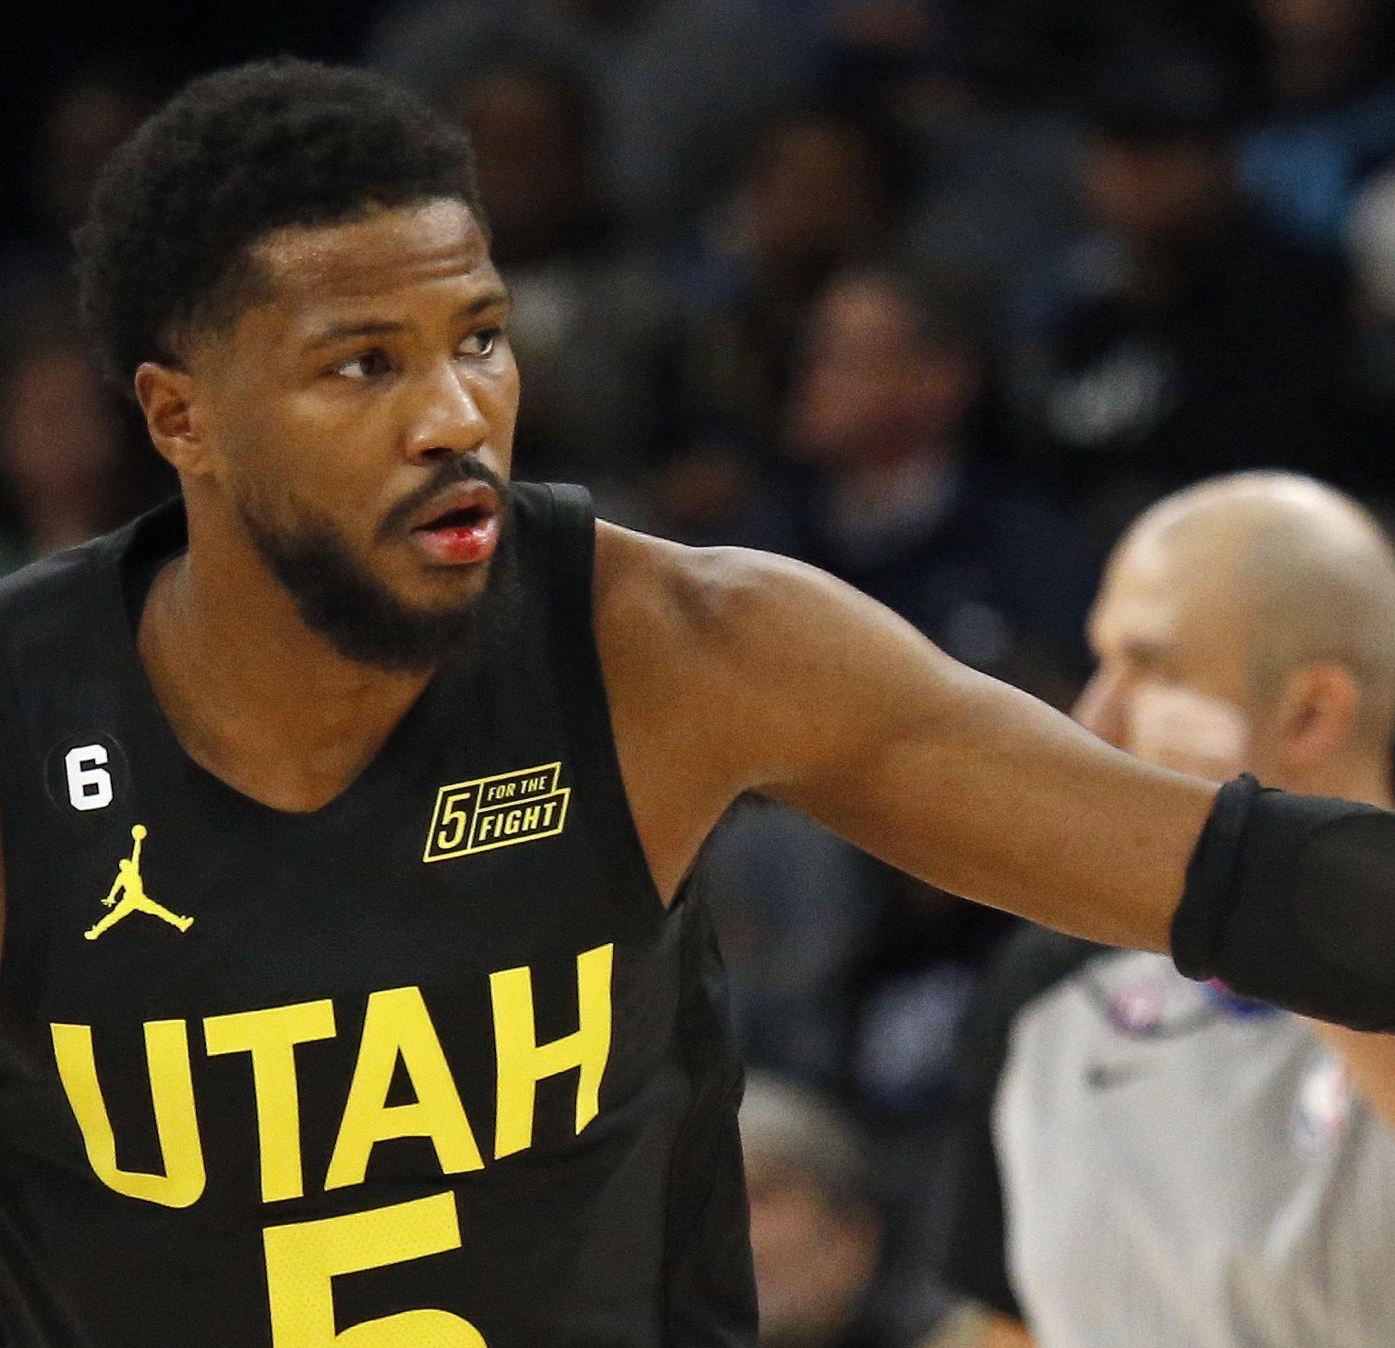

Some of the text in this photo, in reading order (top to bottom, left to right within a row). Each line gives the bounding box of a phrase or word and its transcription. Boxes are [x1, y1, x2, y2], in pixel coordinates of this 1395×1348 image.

[65, 744, 114, 811] 6
[487, 775, 548, 802] FOR THE
[437, 792, 471, 849] 5
[478, 802, 558, 842] FIGHT
[50, 943, 614, 1209] UTAH
